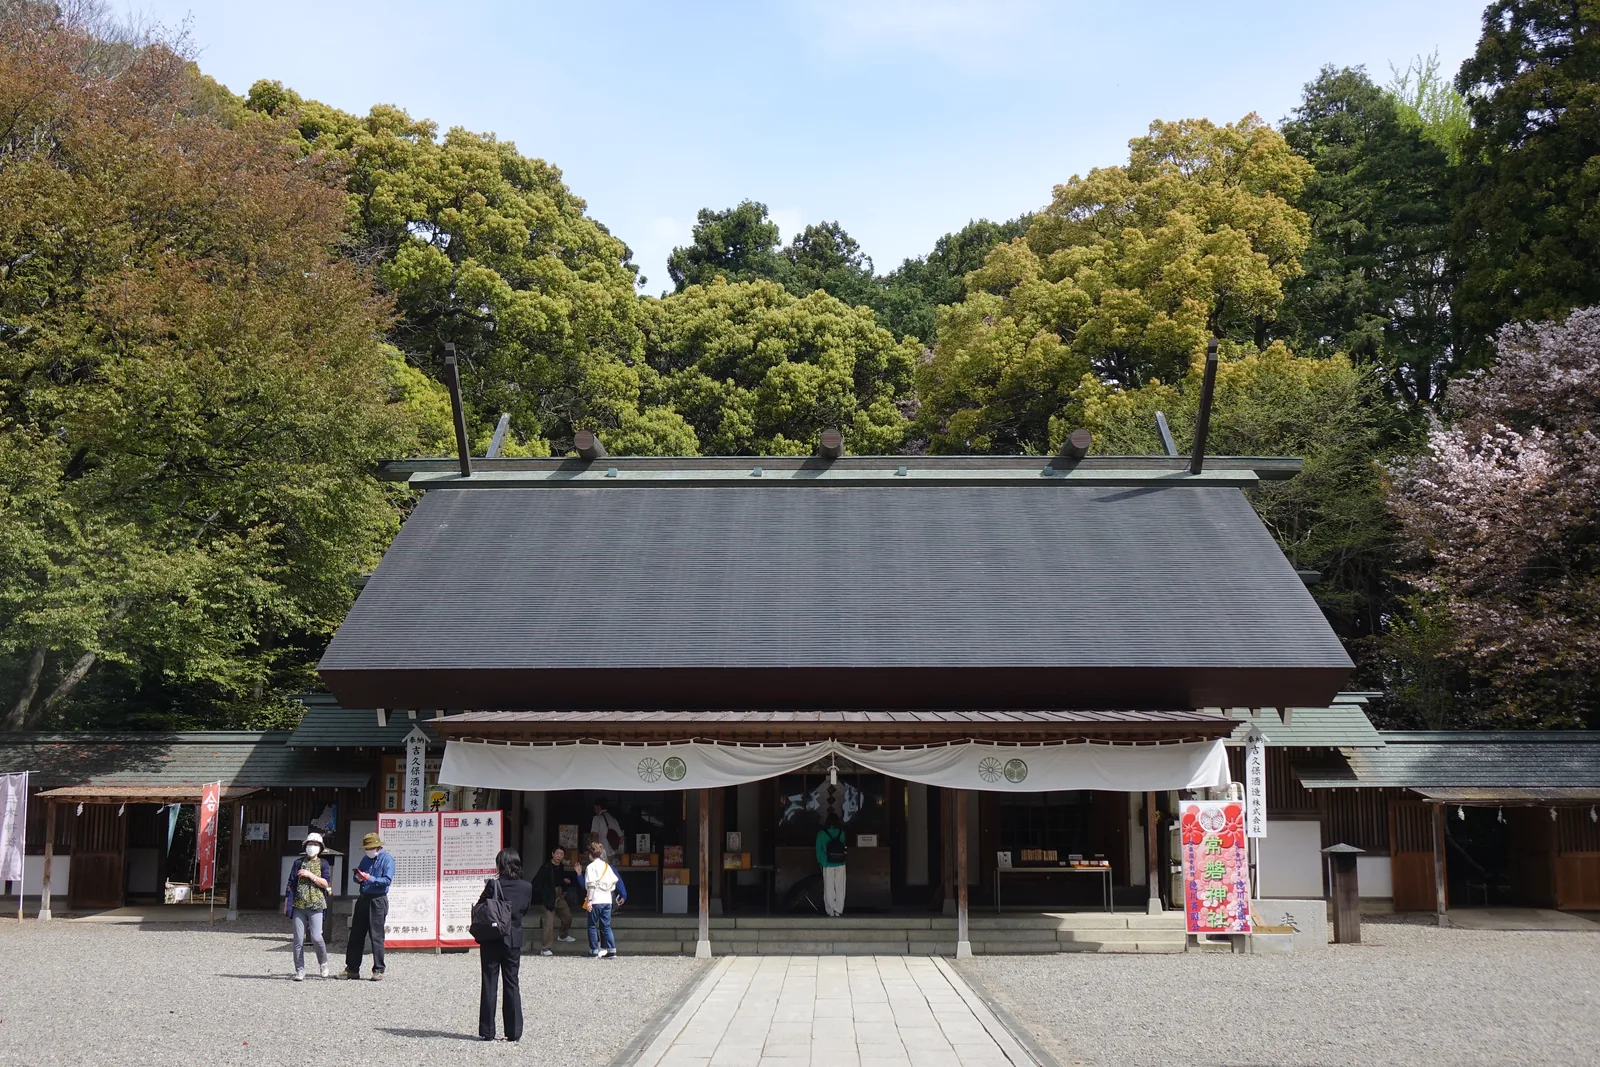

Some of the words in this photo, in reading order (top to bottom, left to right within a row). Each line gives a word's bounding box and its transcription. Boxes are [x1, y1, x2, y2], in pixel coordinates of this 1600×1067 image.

[409, 736, 425, 744] 奉納
[1251, 745, 1261, 834] 吉久保酒造株式会社
[397, 819, 434, 828] 方位除け表
[460, 818, 495, 828] 厄年表
[1204, 836, 1231, 928] 常磐神社
[392, 925, 428, 934] 常磐神社
